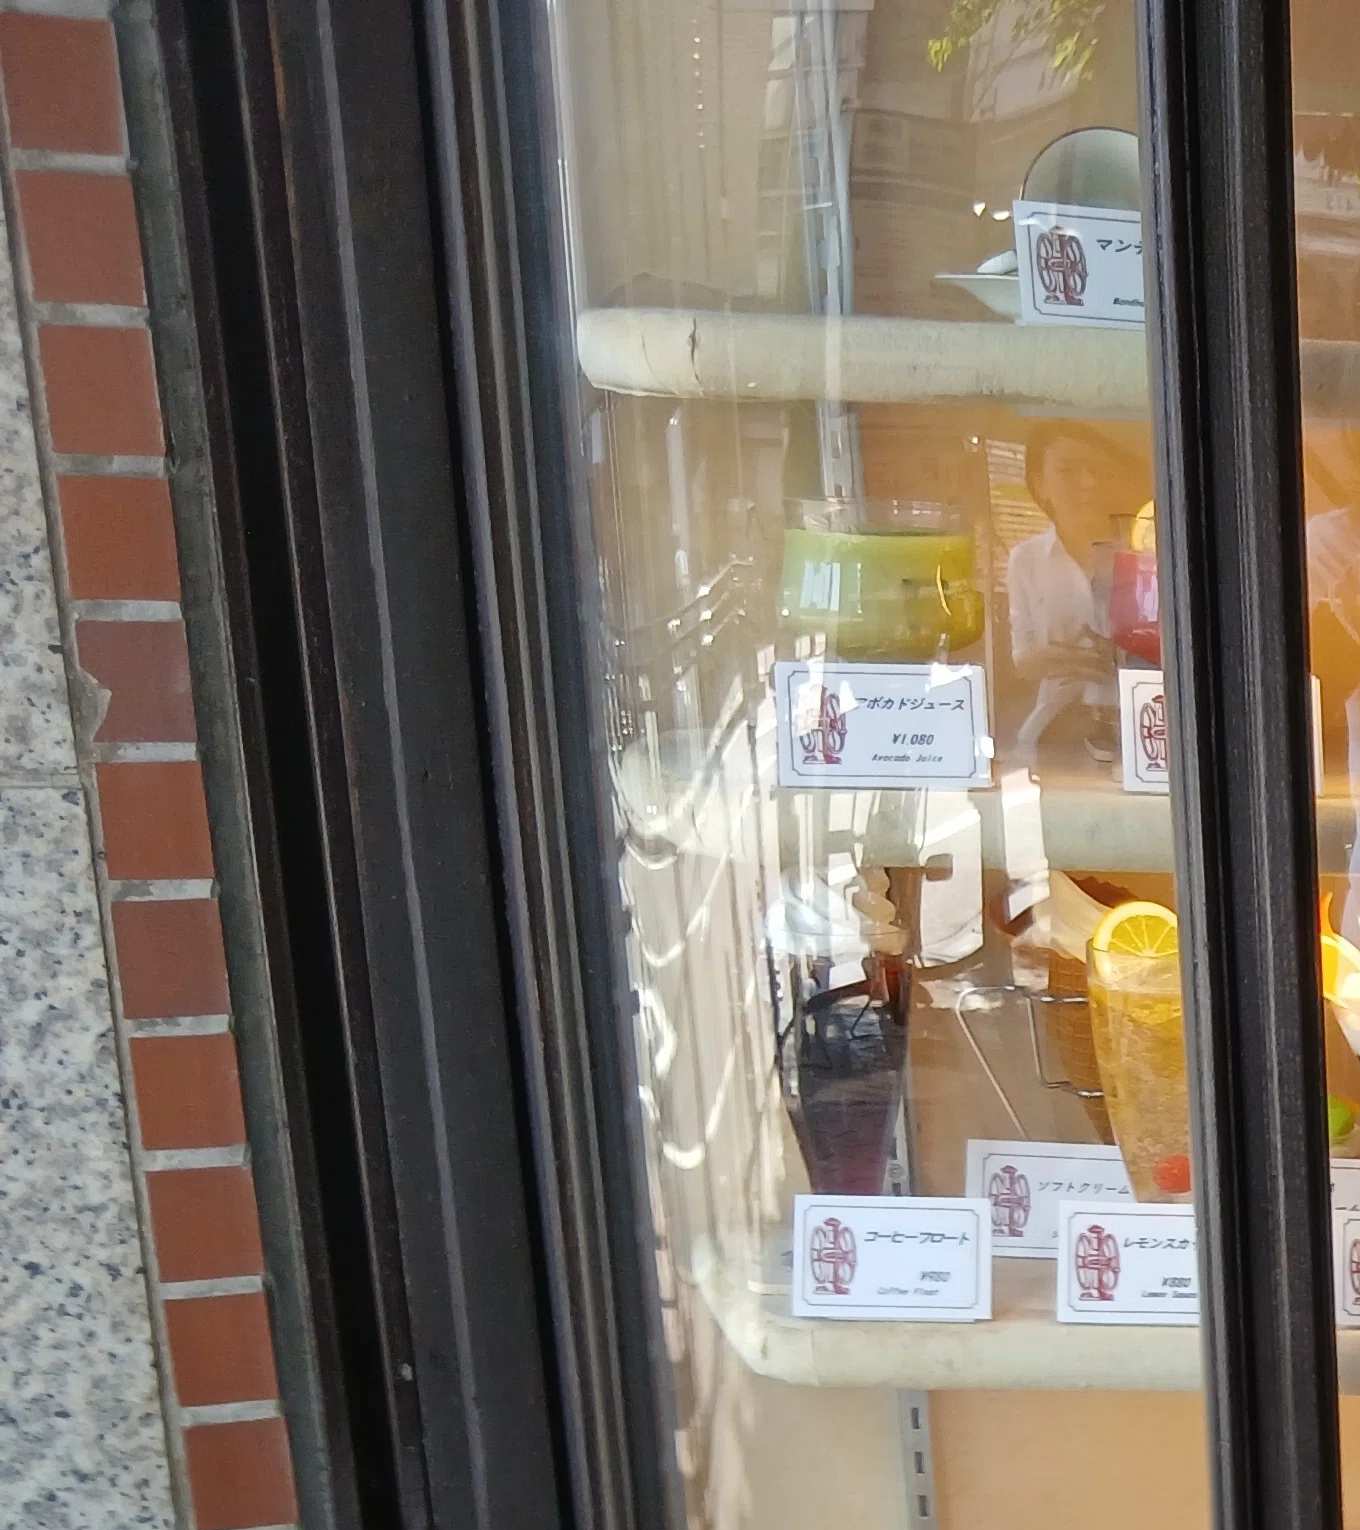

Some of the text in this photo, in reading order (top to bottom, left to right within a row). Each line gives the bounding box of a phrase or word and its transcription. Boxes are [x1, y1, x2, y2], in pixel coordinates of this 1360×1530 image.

[872, 753, 943, 763] Avocado Juice
[863, 1231, 970, 1245] コーヒーフロート
